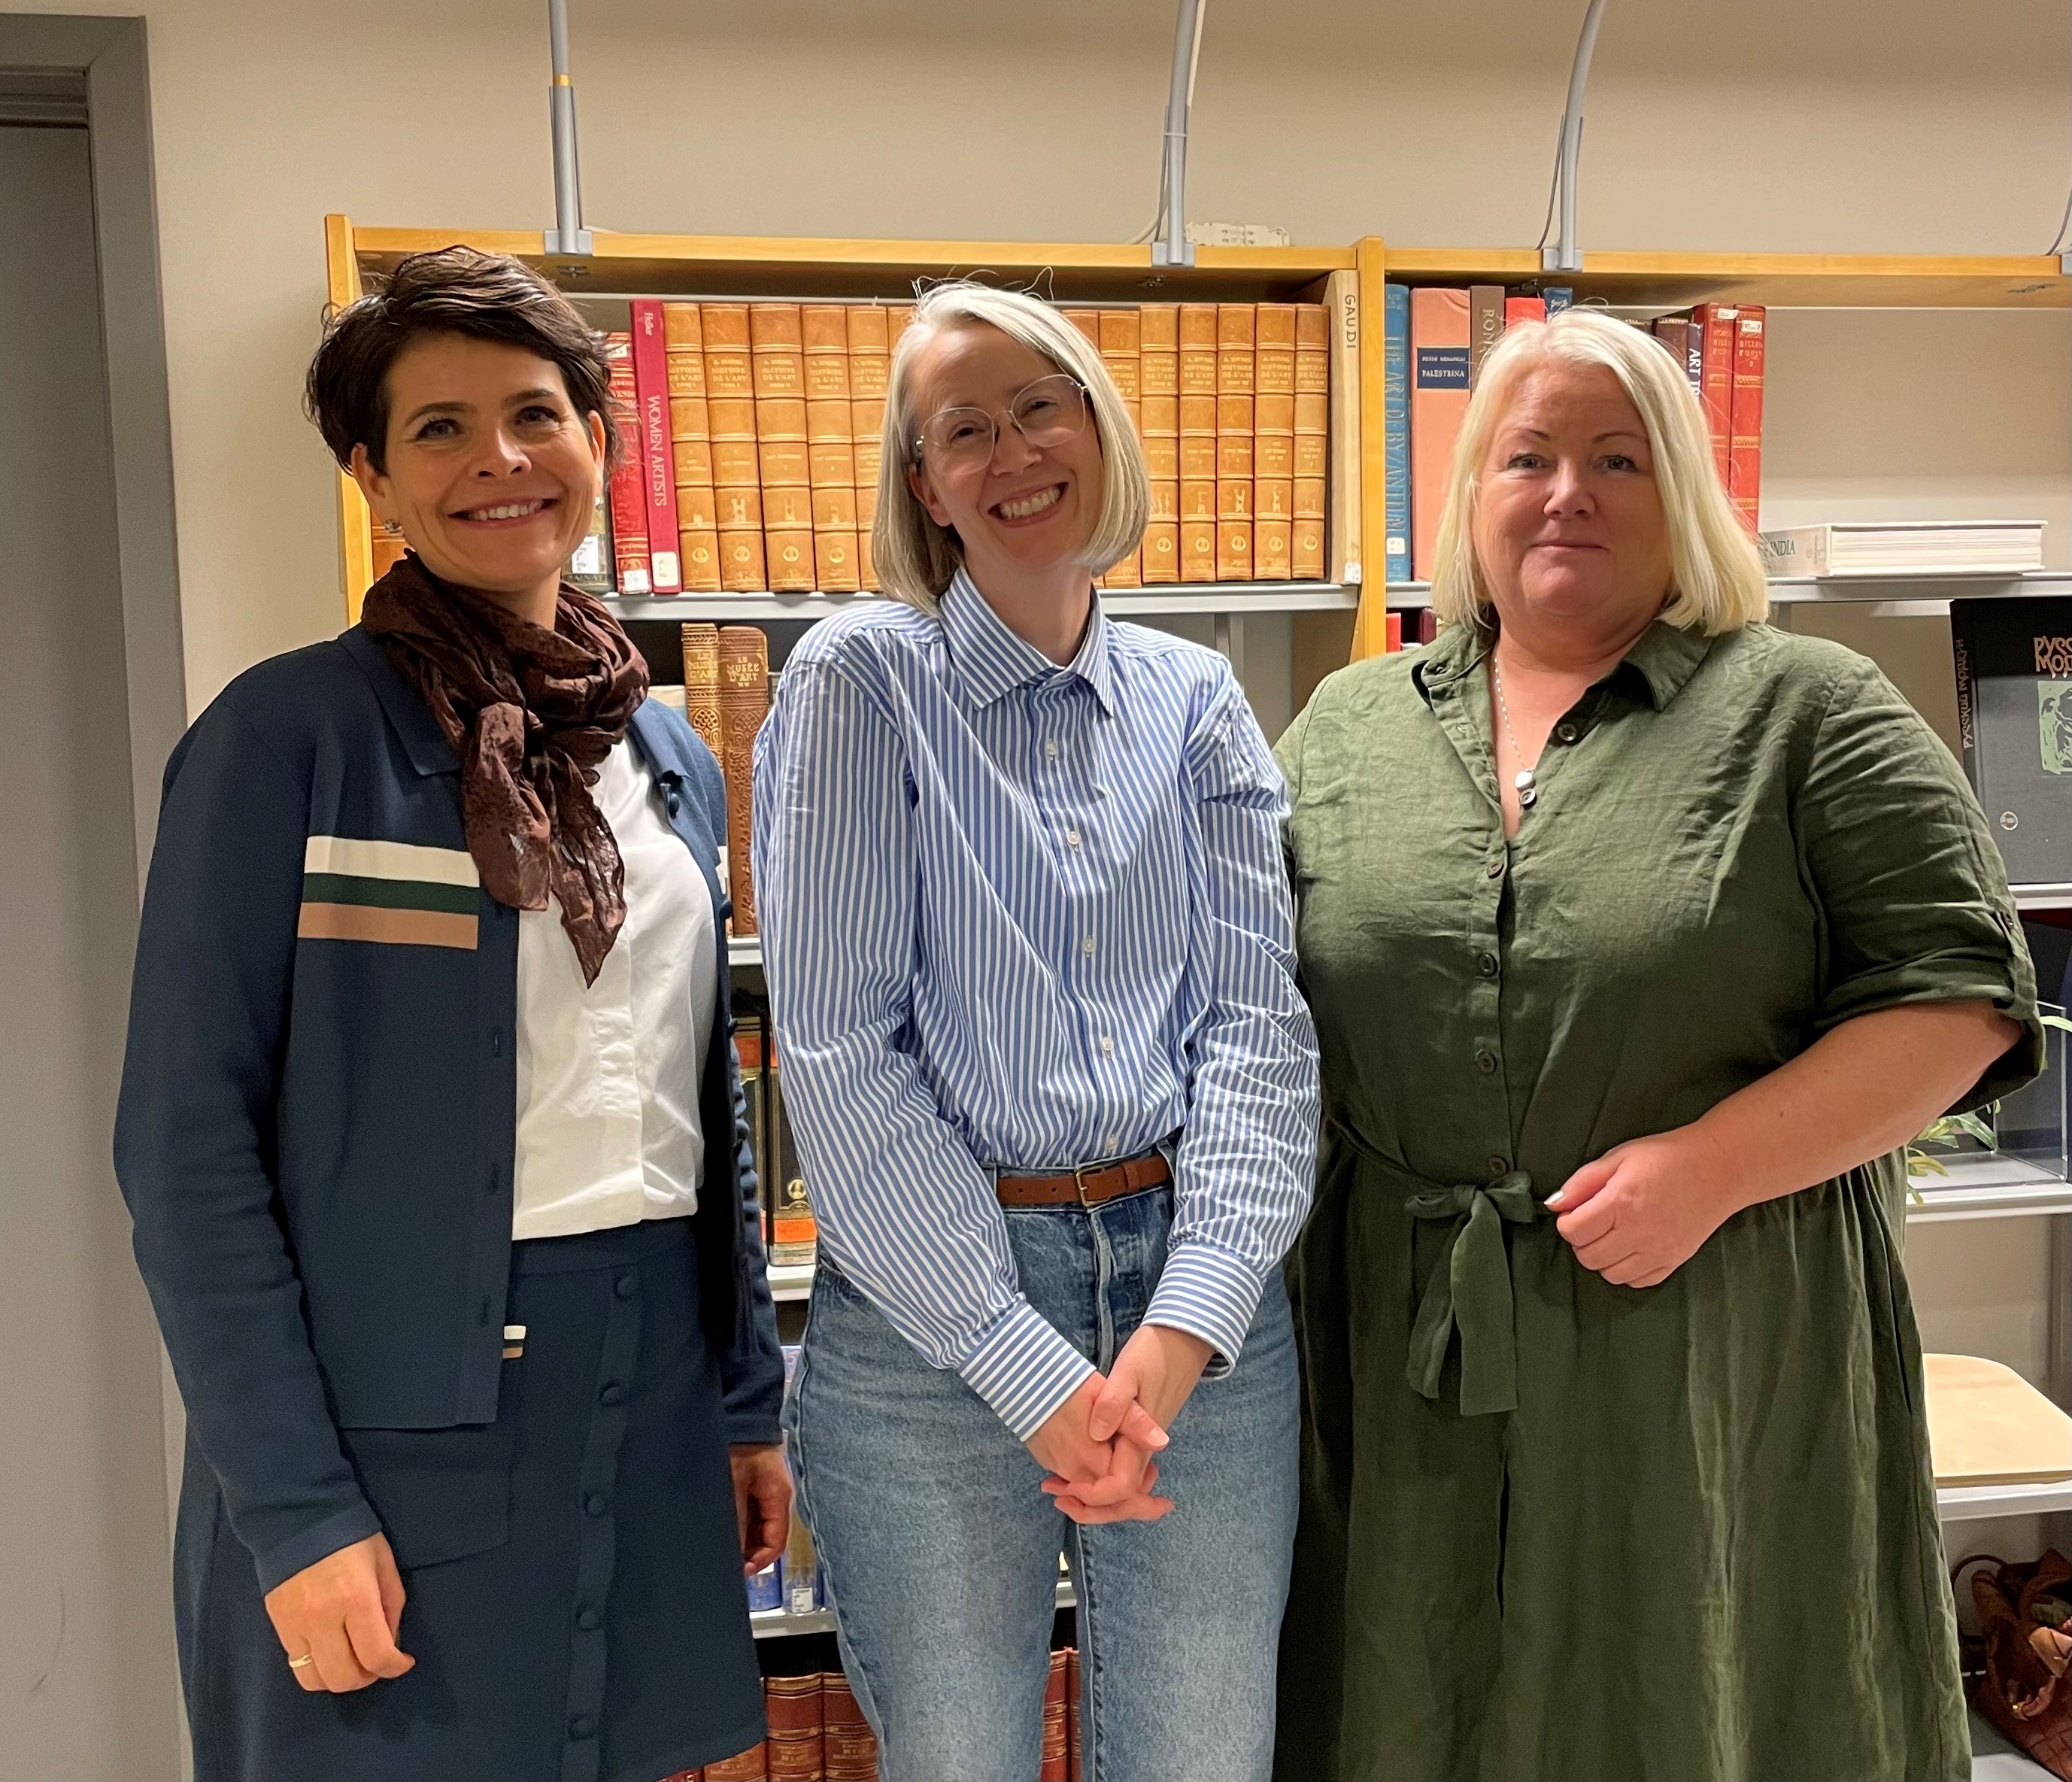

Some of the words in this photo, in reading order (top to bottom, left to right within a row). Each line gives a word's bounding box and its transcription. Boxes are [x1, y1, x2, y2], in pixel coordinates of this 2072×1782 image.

[1345, 294, 1356, 348] GAUDI
[1385, 335, 1405, 367] THE
[1689, 348, 1701, 376] ART
[1385, 371, 1405, 405] ART
[1421, 369, 1465, 378] PALESTRINA
[648, 395, 663, 451] WOMEN
[1385, 408, 1405, 427] OF
[651, 455, 668, 507] ARTISTS
[1385, 432, 1406, 532] BYZANTIUM
[727, 663, 760, 672] MUSÉE
[727, 669, 758, 682] D'ART
